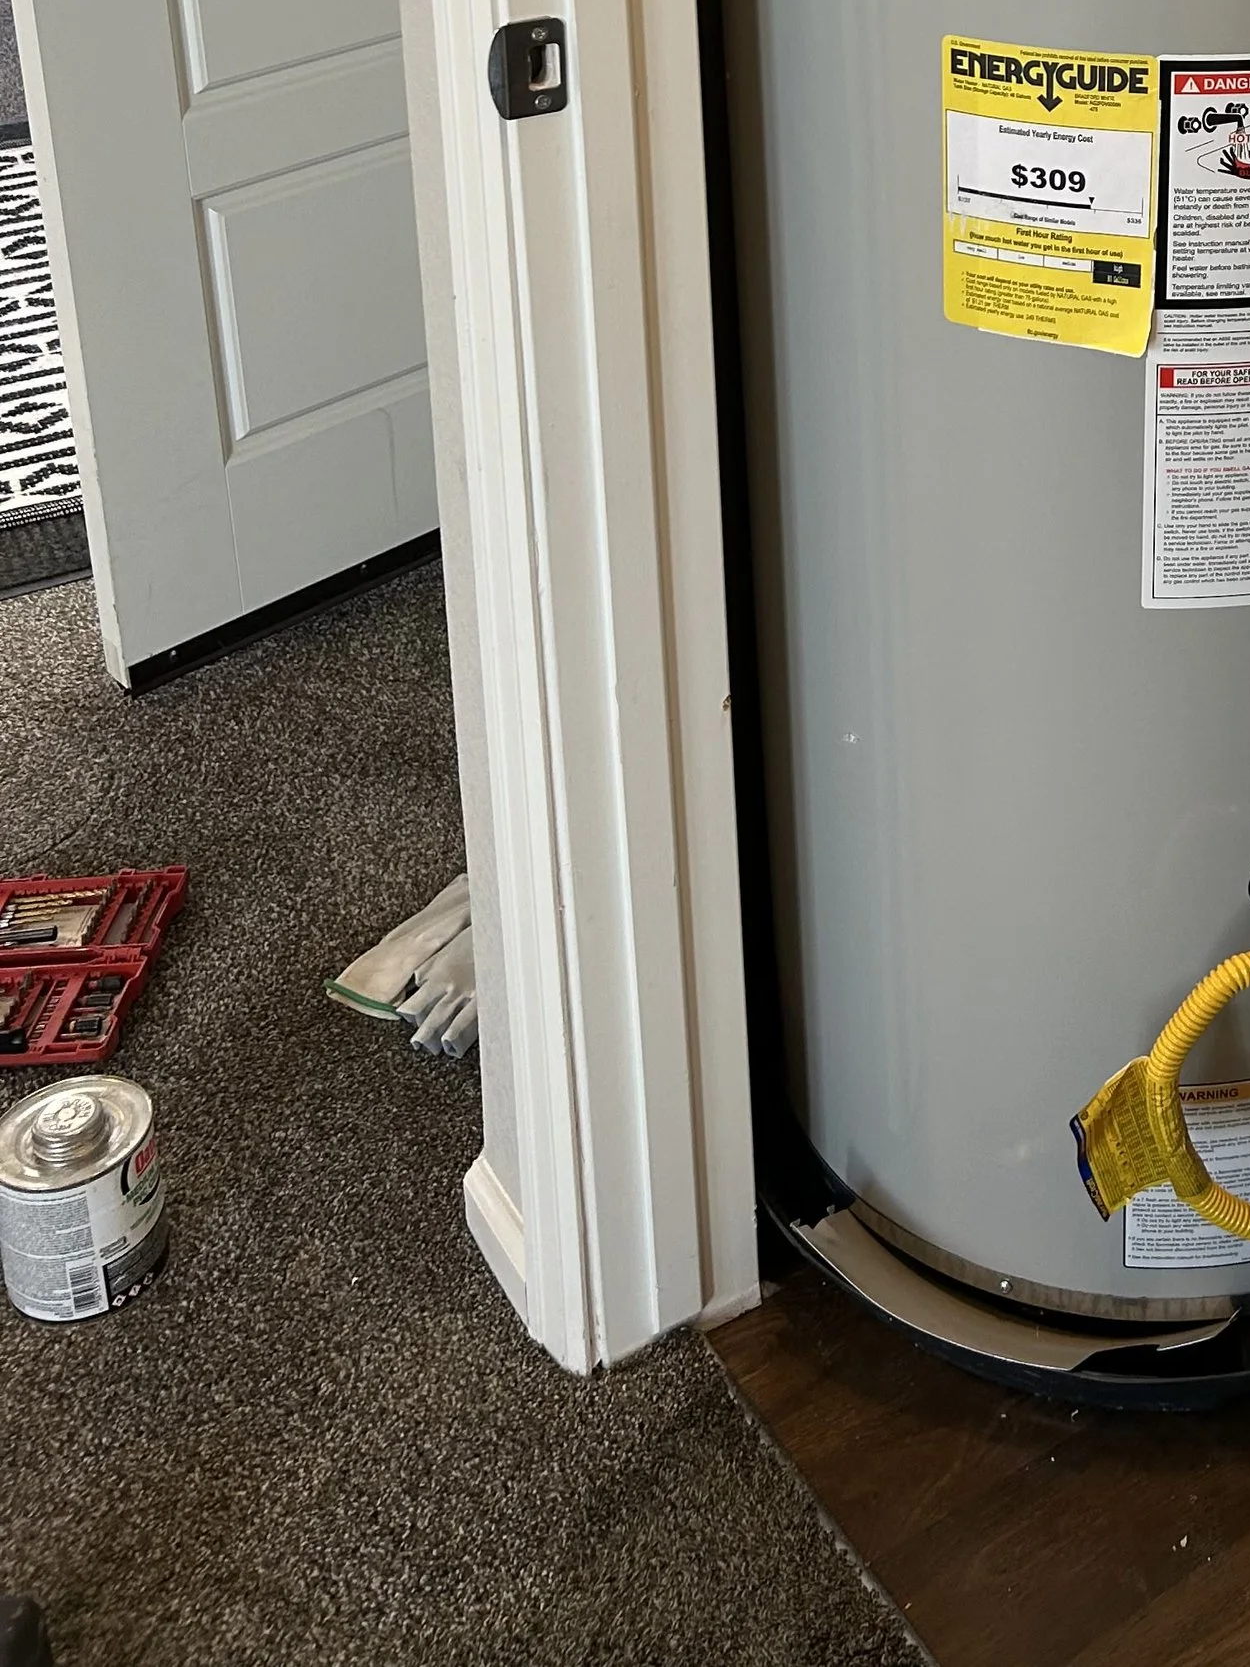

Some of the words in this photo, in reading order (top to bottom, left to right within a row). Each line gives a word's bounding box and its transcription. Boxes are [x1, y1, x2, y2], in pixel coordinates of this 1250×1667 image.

[950, 47, 1149, 95] ENERGYGUIDE
[999, 124, 1031, 137] Estimated
[1031, 129, 1052, 141] Yearly
[1053, 131, 1076, 143] Energy
[1077, 134, 1094, 143] Cost
[1010, 163, 1086, 193] $309
[1195, 222, 1220, 230] highest
[1016, 227, 1031, 237] First
[1032, 229, 1050, 239] Hour
[1050, 231, 1073, 244] Rating
[1200, 376, 1231, 384] BEFORE
